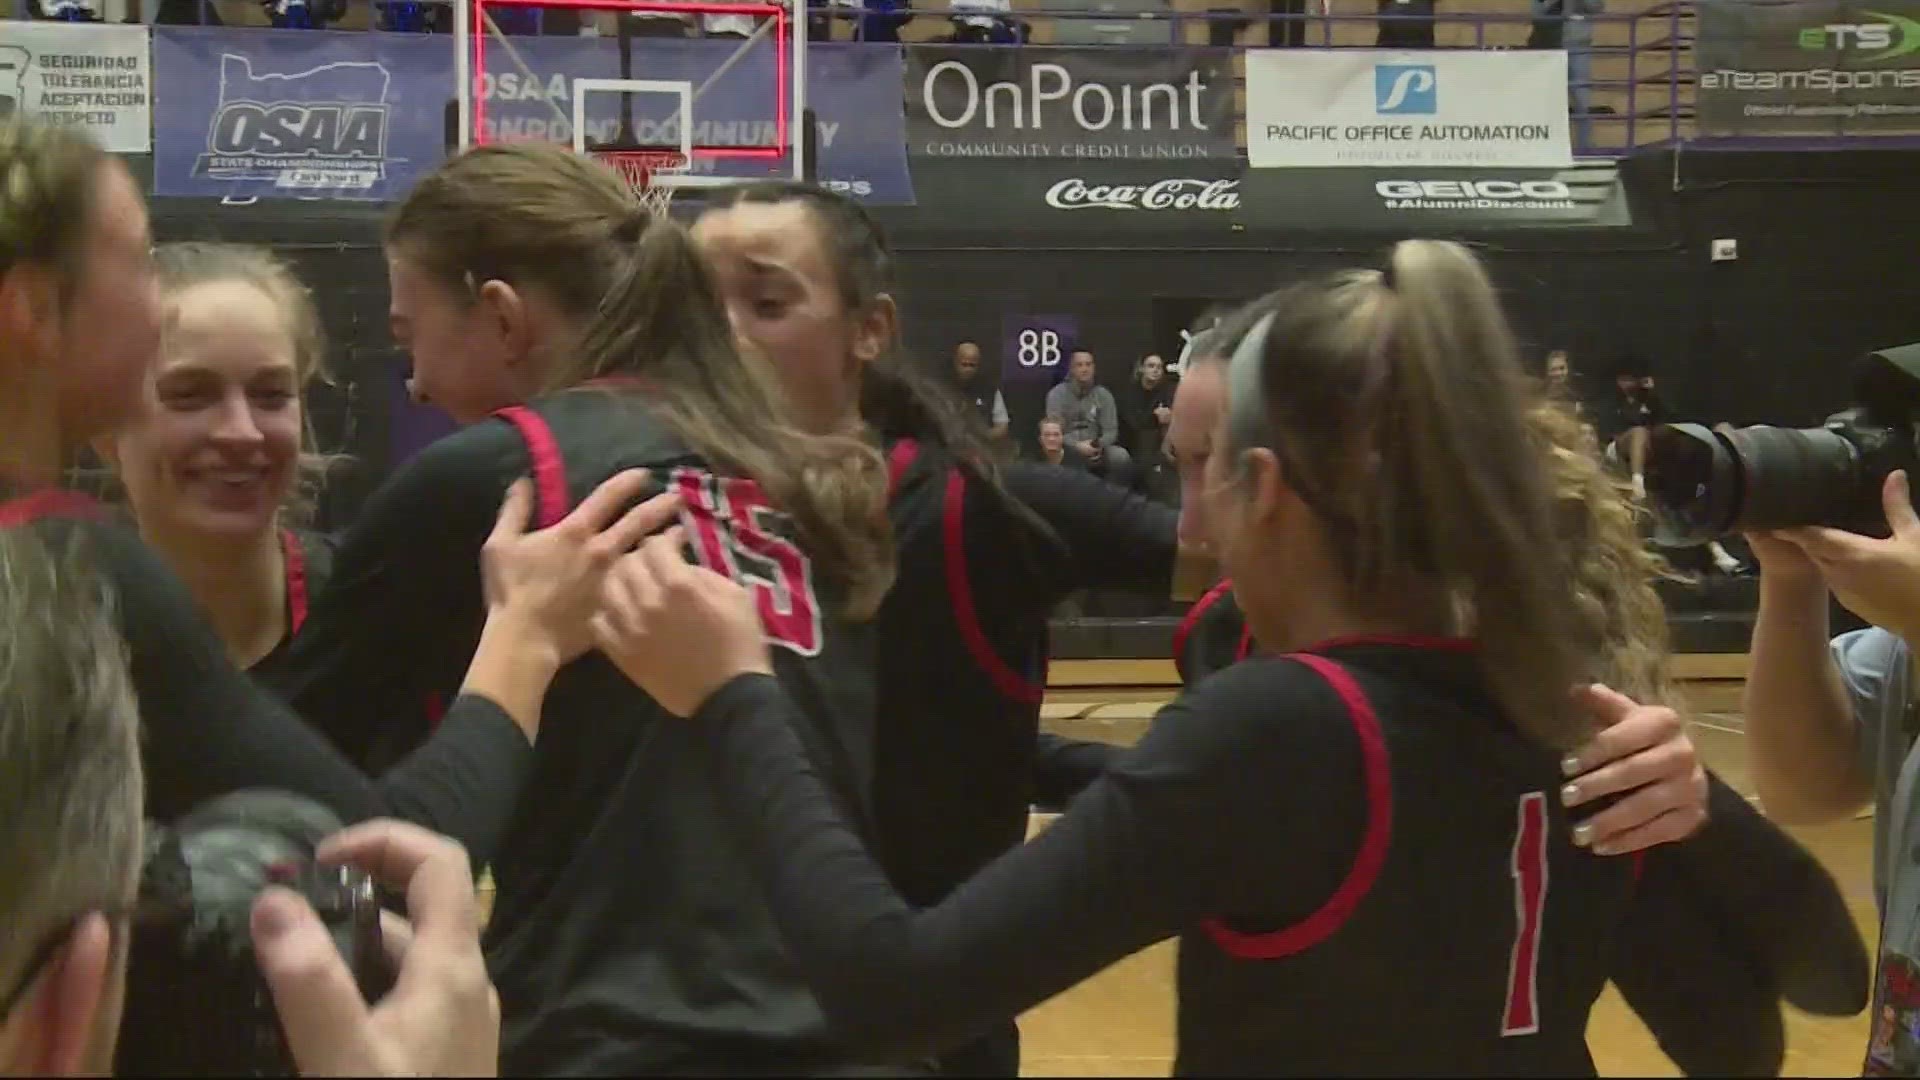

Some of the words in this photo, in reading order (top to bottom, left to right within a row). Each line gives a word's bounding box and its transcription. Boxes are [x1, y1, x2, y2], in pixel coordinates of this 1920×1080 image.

[39, 55, 137, 69] SEGURIDAD
[40, 73, 144, 88] TOLERANCIA
[472, 73, 568, 100] OSAA
[923, 61, 1209, 130] OnPoint
[212, 104, 386, 158] OSAA
[1266, 125, 1338, 141] PACIFIC
[1345, 125, 1413, 140] OFFICE
[1420, 124, 1550, 141] AUTOMATION
[926, 141, 1050, 158] COMMUNITY
[1061, 143, 1129, 159] CREDIT
[1141, 143, 1208, 159] UNION
[1045, 179, 1241, 209] Coca-Cola
[1375, 180, 1570, 199] GEICO
[1018, 329, 1062, 366] 8B
[667, 466, 822, 657] 15
[1501, 791, 1548, 1037] 1
